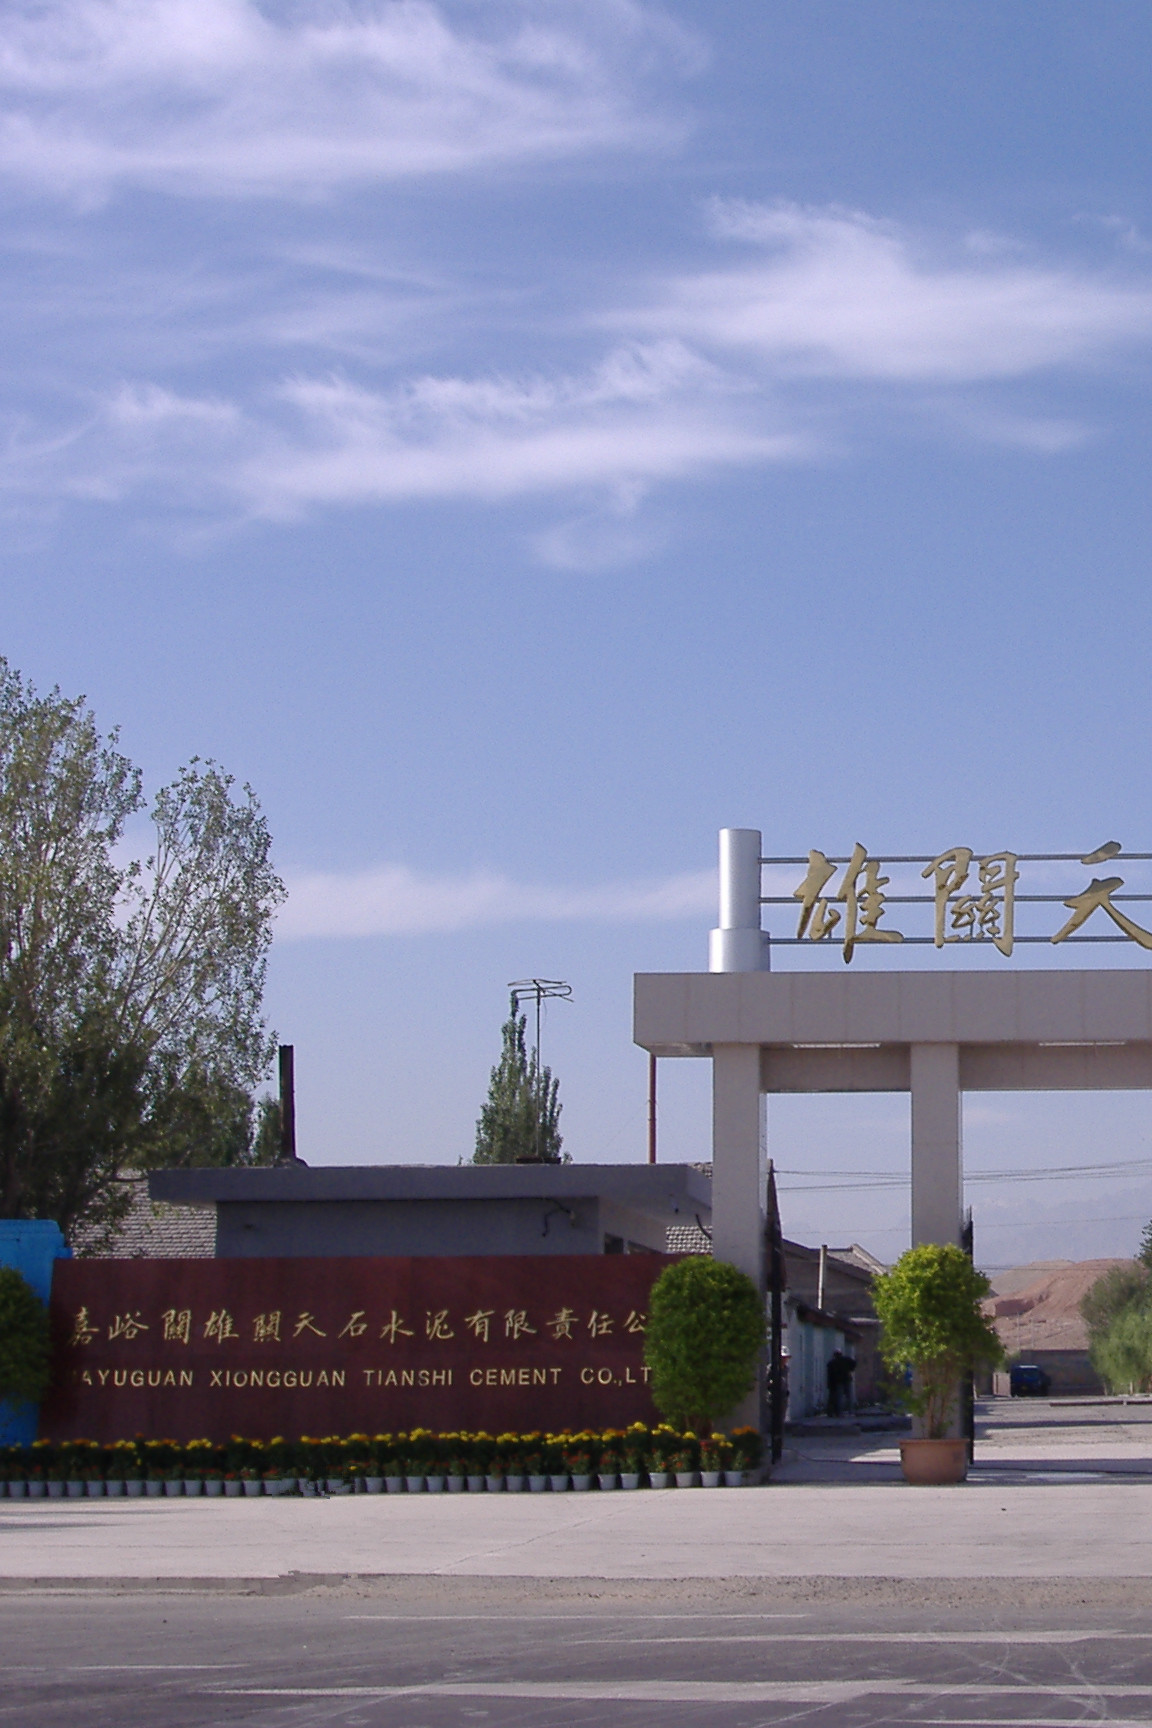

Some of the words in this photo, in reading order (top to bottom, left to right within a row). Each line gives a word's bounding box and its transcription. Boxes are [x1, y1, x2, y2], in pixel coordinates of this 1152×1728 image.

[73, 1369, 194, 1388] AYUGUAN
[210, 1369, 346, 1388] XIONGGUAN
[363, 1369, 453, 1387] TIANSHI
[469, 1367, 563, 1387] CEMENT
